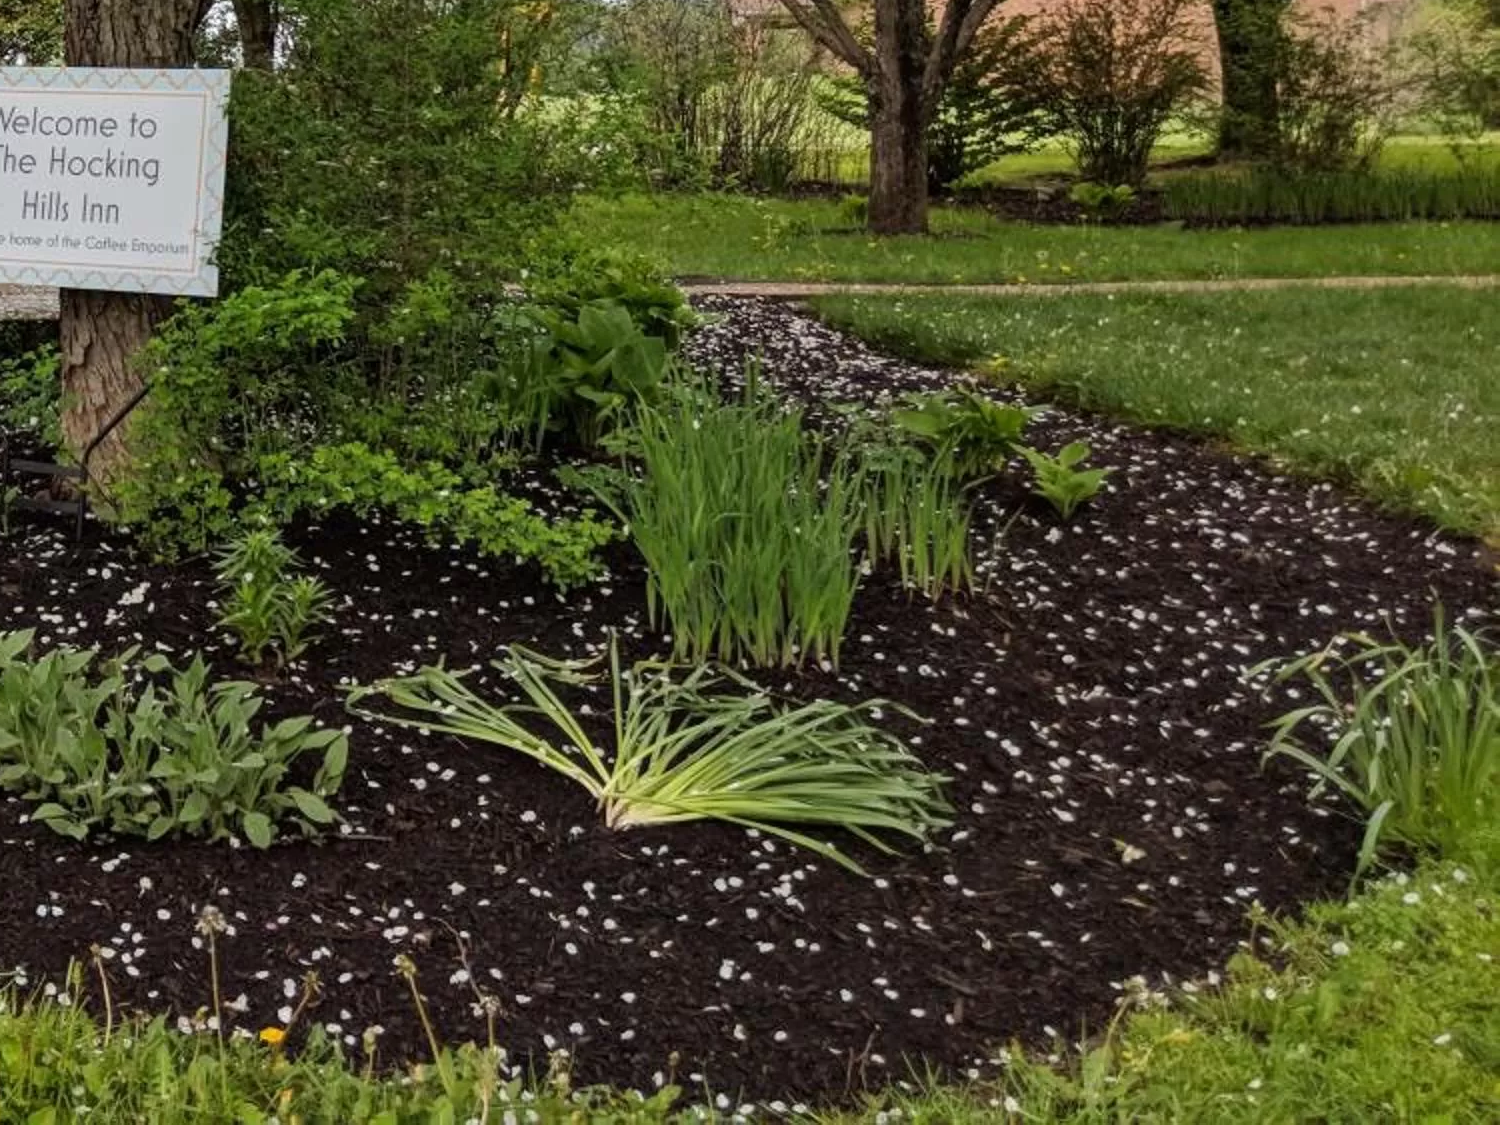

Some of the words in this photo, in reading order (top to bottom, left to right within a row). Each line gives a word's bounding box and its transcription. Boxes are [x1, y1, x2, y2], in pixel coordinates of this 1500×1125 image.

[129, 111, 158, 138] to
[49, 146, 160, 186] Hocking
[21, 190, 69, 222] Hills
[82, 193, 120, 224] Inn
[9, 233, 43, 247] home
[47, 235, 60, 248] of
[61, 236, 81, 249] the
[85, 237, 127, 251] Coffee
[131, 238, 190, 255] Emporium
